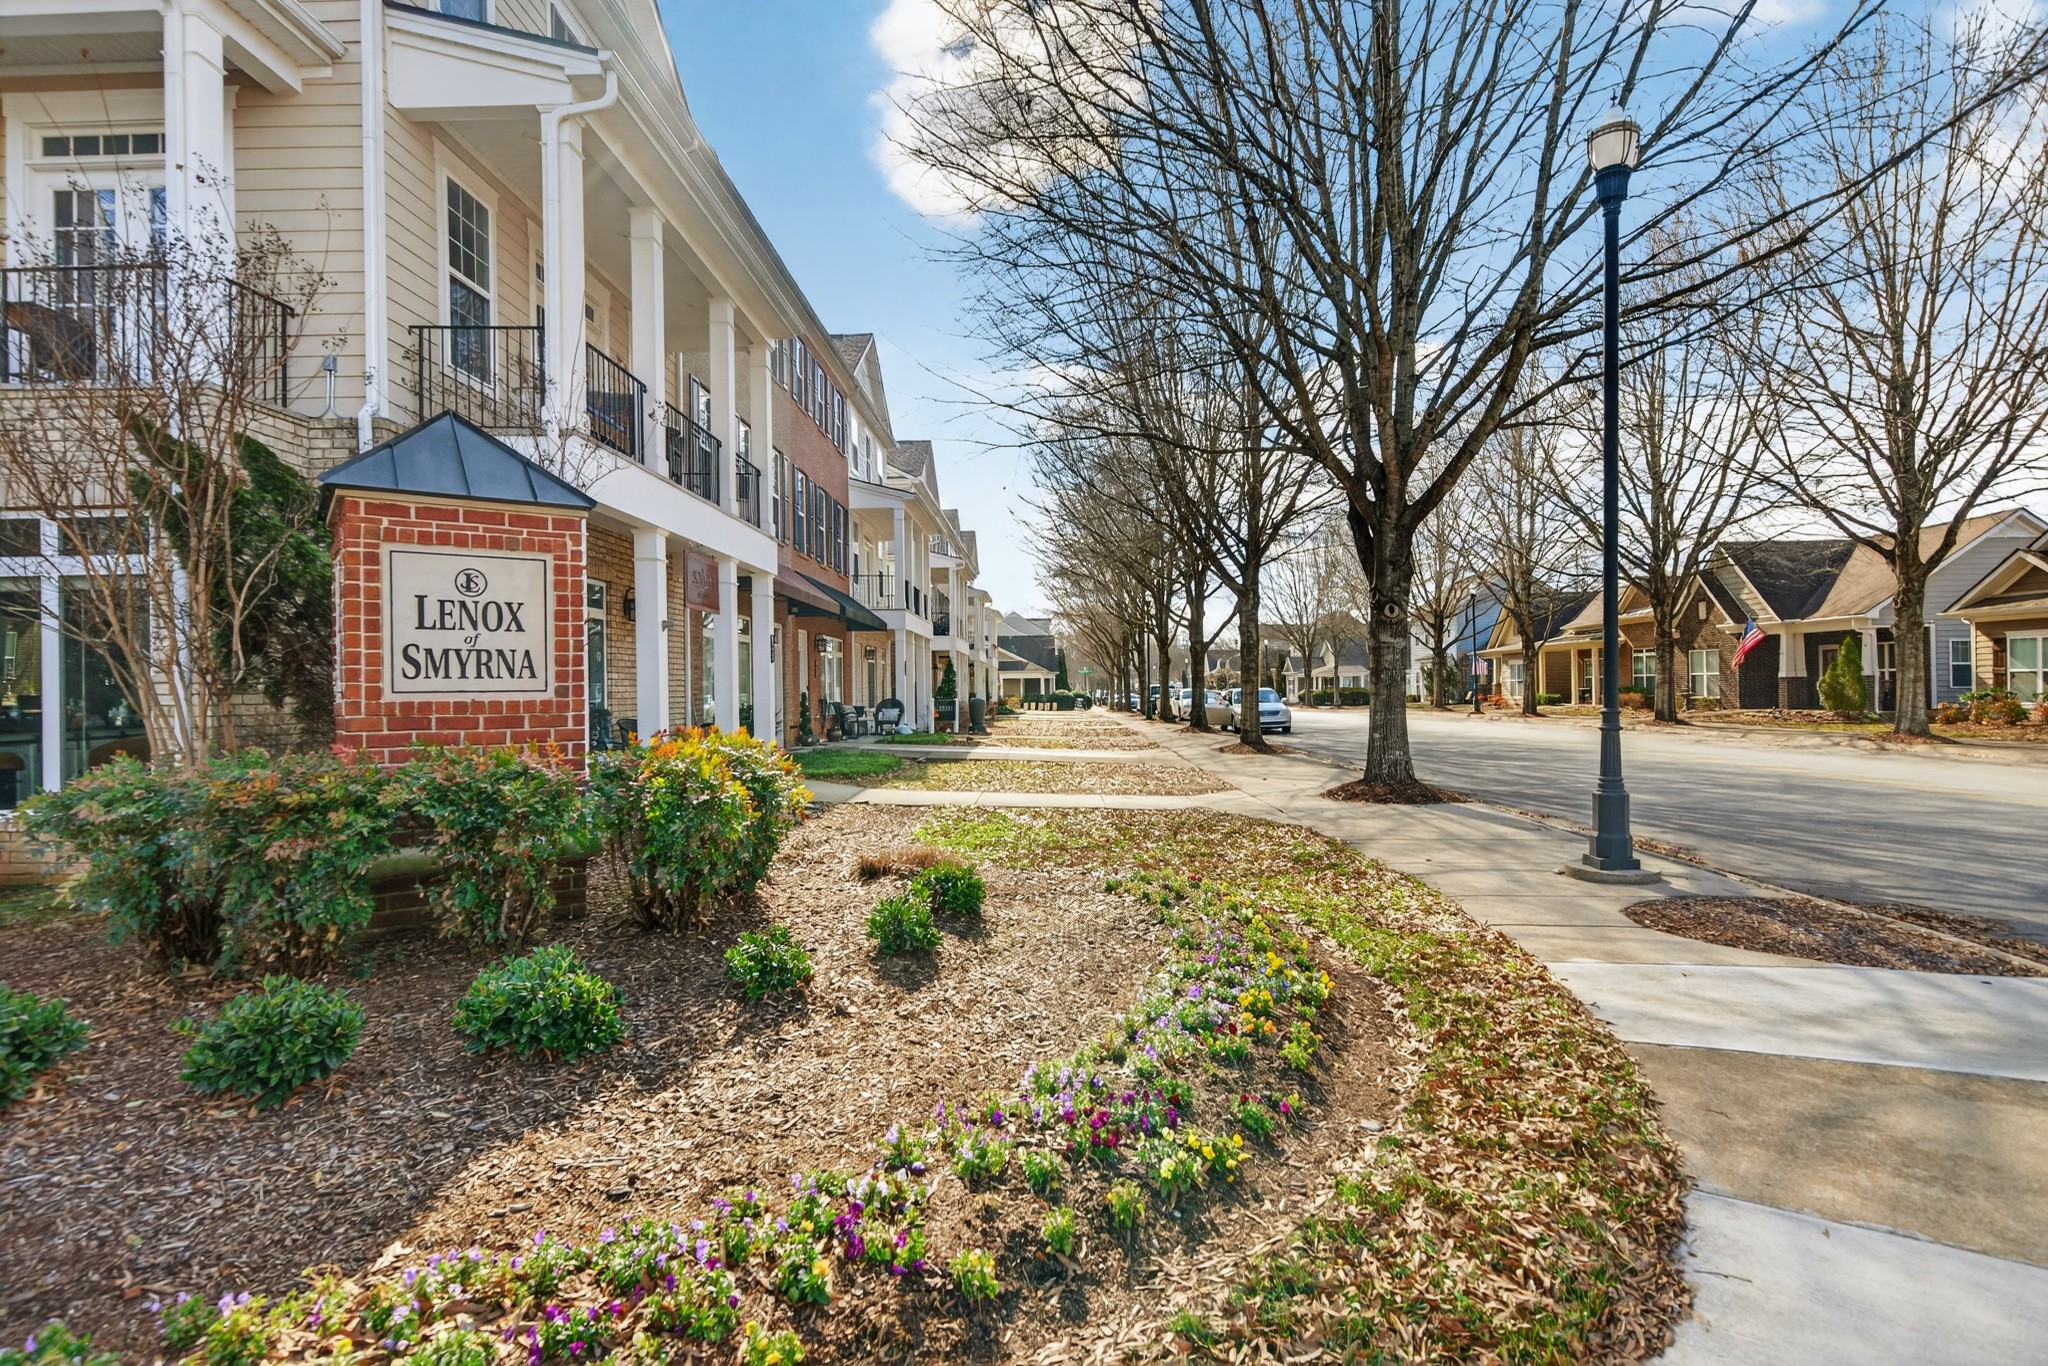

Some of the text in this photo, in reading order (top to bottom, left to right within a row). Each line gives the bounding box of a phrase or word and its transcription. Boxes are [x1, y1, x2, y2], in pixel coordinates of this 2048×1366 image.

[414, 594, 526, 632] LENOX
[464, 633, 482, 647] of
[401, 643, 539, 680] SMYRNA
